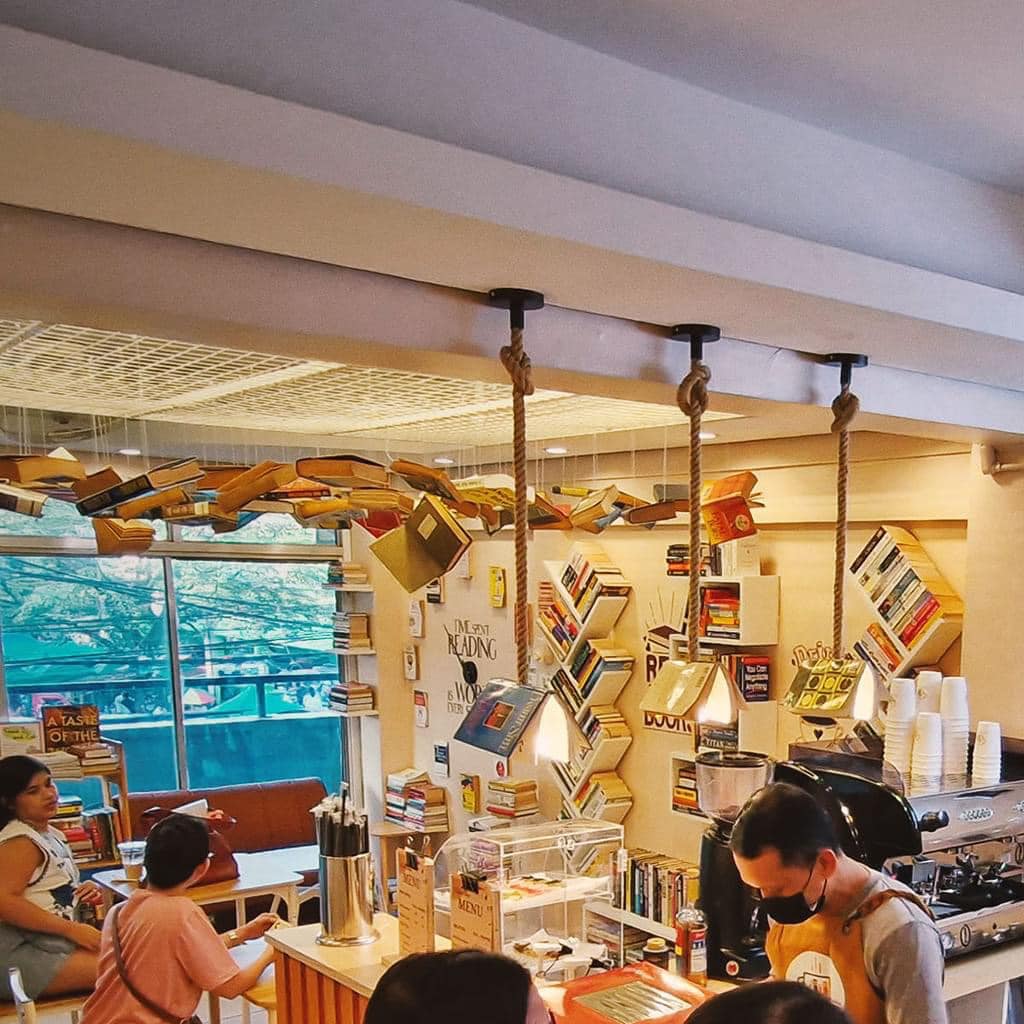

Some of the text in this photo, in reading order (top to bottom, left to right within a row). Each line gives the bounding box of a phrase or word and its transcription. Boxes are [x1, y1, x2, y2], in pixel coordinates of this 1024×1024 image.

[448, 633, 497, 660] READING
[47, 715, 98, 727] A TASTE
[50, 731, 69, 743] OF
[75, 730, 98, 743] THE
[457, 898, 483, 917] MENU
